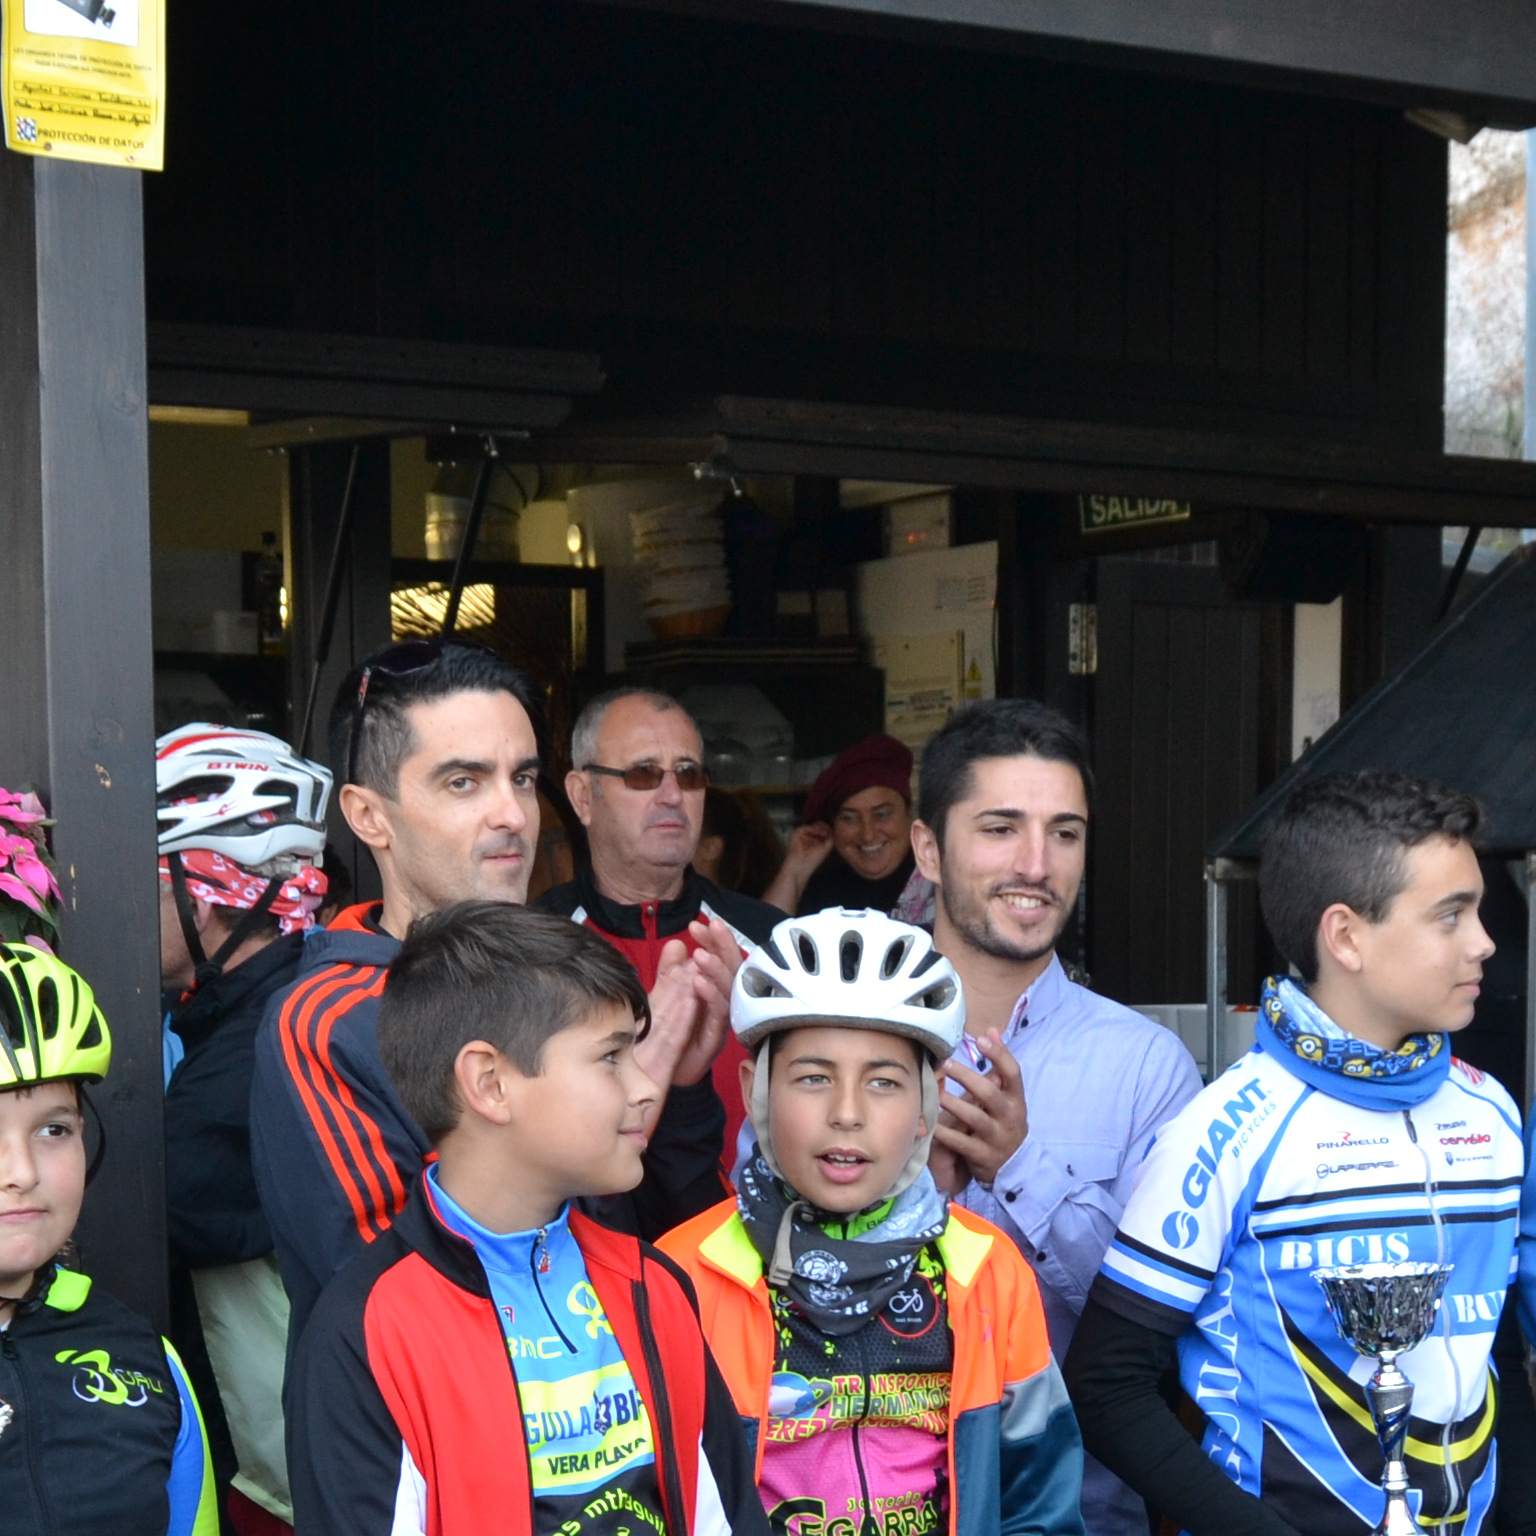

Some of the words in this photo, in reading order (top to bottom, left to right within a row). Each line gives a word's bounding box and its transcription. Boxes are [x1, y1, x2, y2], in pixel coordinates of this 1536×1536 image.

[38, 127, 96, 145] PROTECCIÓN
[99, 136, 111, 145] DE
[113, 139, 145, 149] DATOS
[1231, 1100, 1277, 1158] BICYCLES
[1182, 1077, 1268, 1209] GIANT
[1316, 1137, 1390, 1151] PINARELLO
[1278, 1232, 1410, 1270] BICIS
[765, 1418, 828, 1442] EREZ
[548, 1453, 590, 1476] VERA
